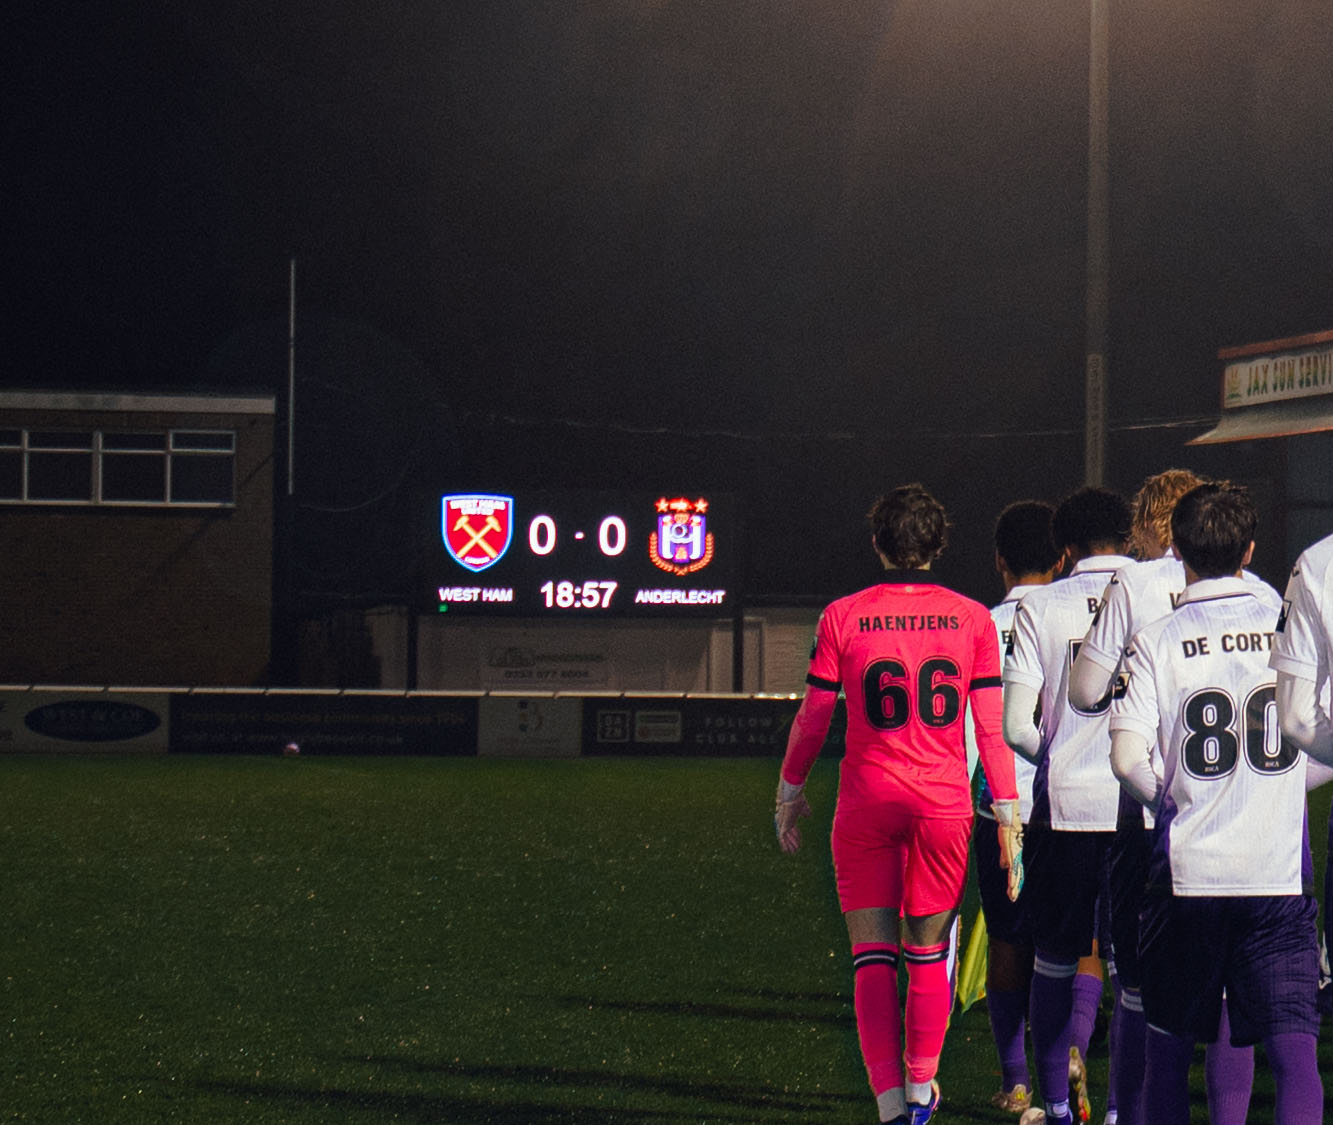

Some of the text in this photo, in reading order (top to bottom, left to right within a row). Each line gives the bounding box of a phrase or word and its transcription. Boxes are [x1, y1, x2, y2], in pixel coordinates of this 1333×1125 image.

[1247, 364, 1269, 396] JAX
[1272, 359, 1295, 392] SUN
[528, 514, 557, 555] 0
[598, 515, 628, 556] 0
[439, 587, 513, 602] WEST HAM
[540, 580, 619, 608] 18:57
[635, 589, 726, 604] ANDERLECHT
[859, 615, 959, 632] HAENTJENS
[1182, 632, 1275, 658] DE CORT
[863, 655, 962, 732] 66
[1181, 682, 1302, 781] 80
